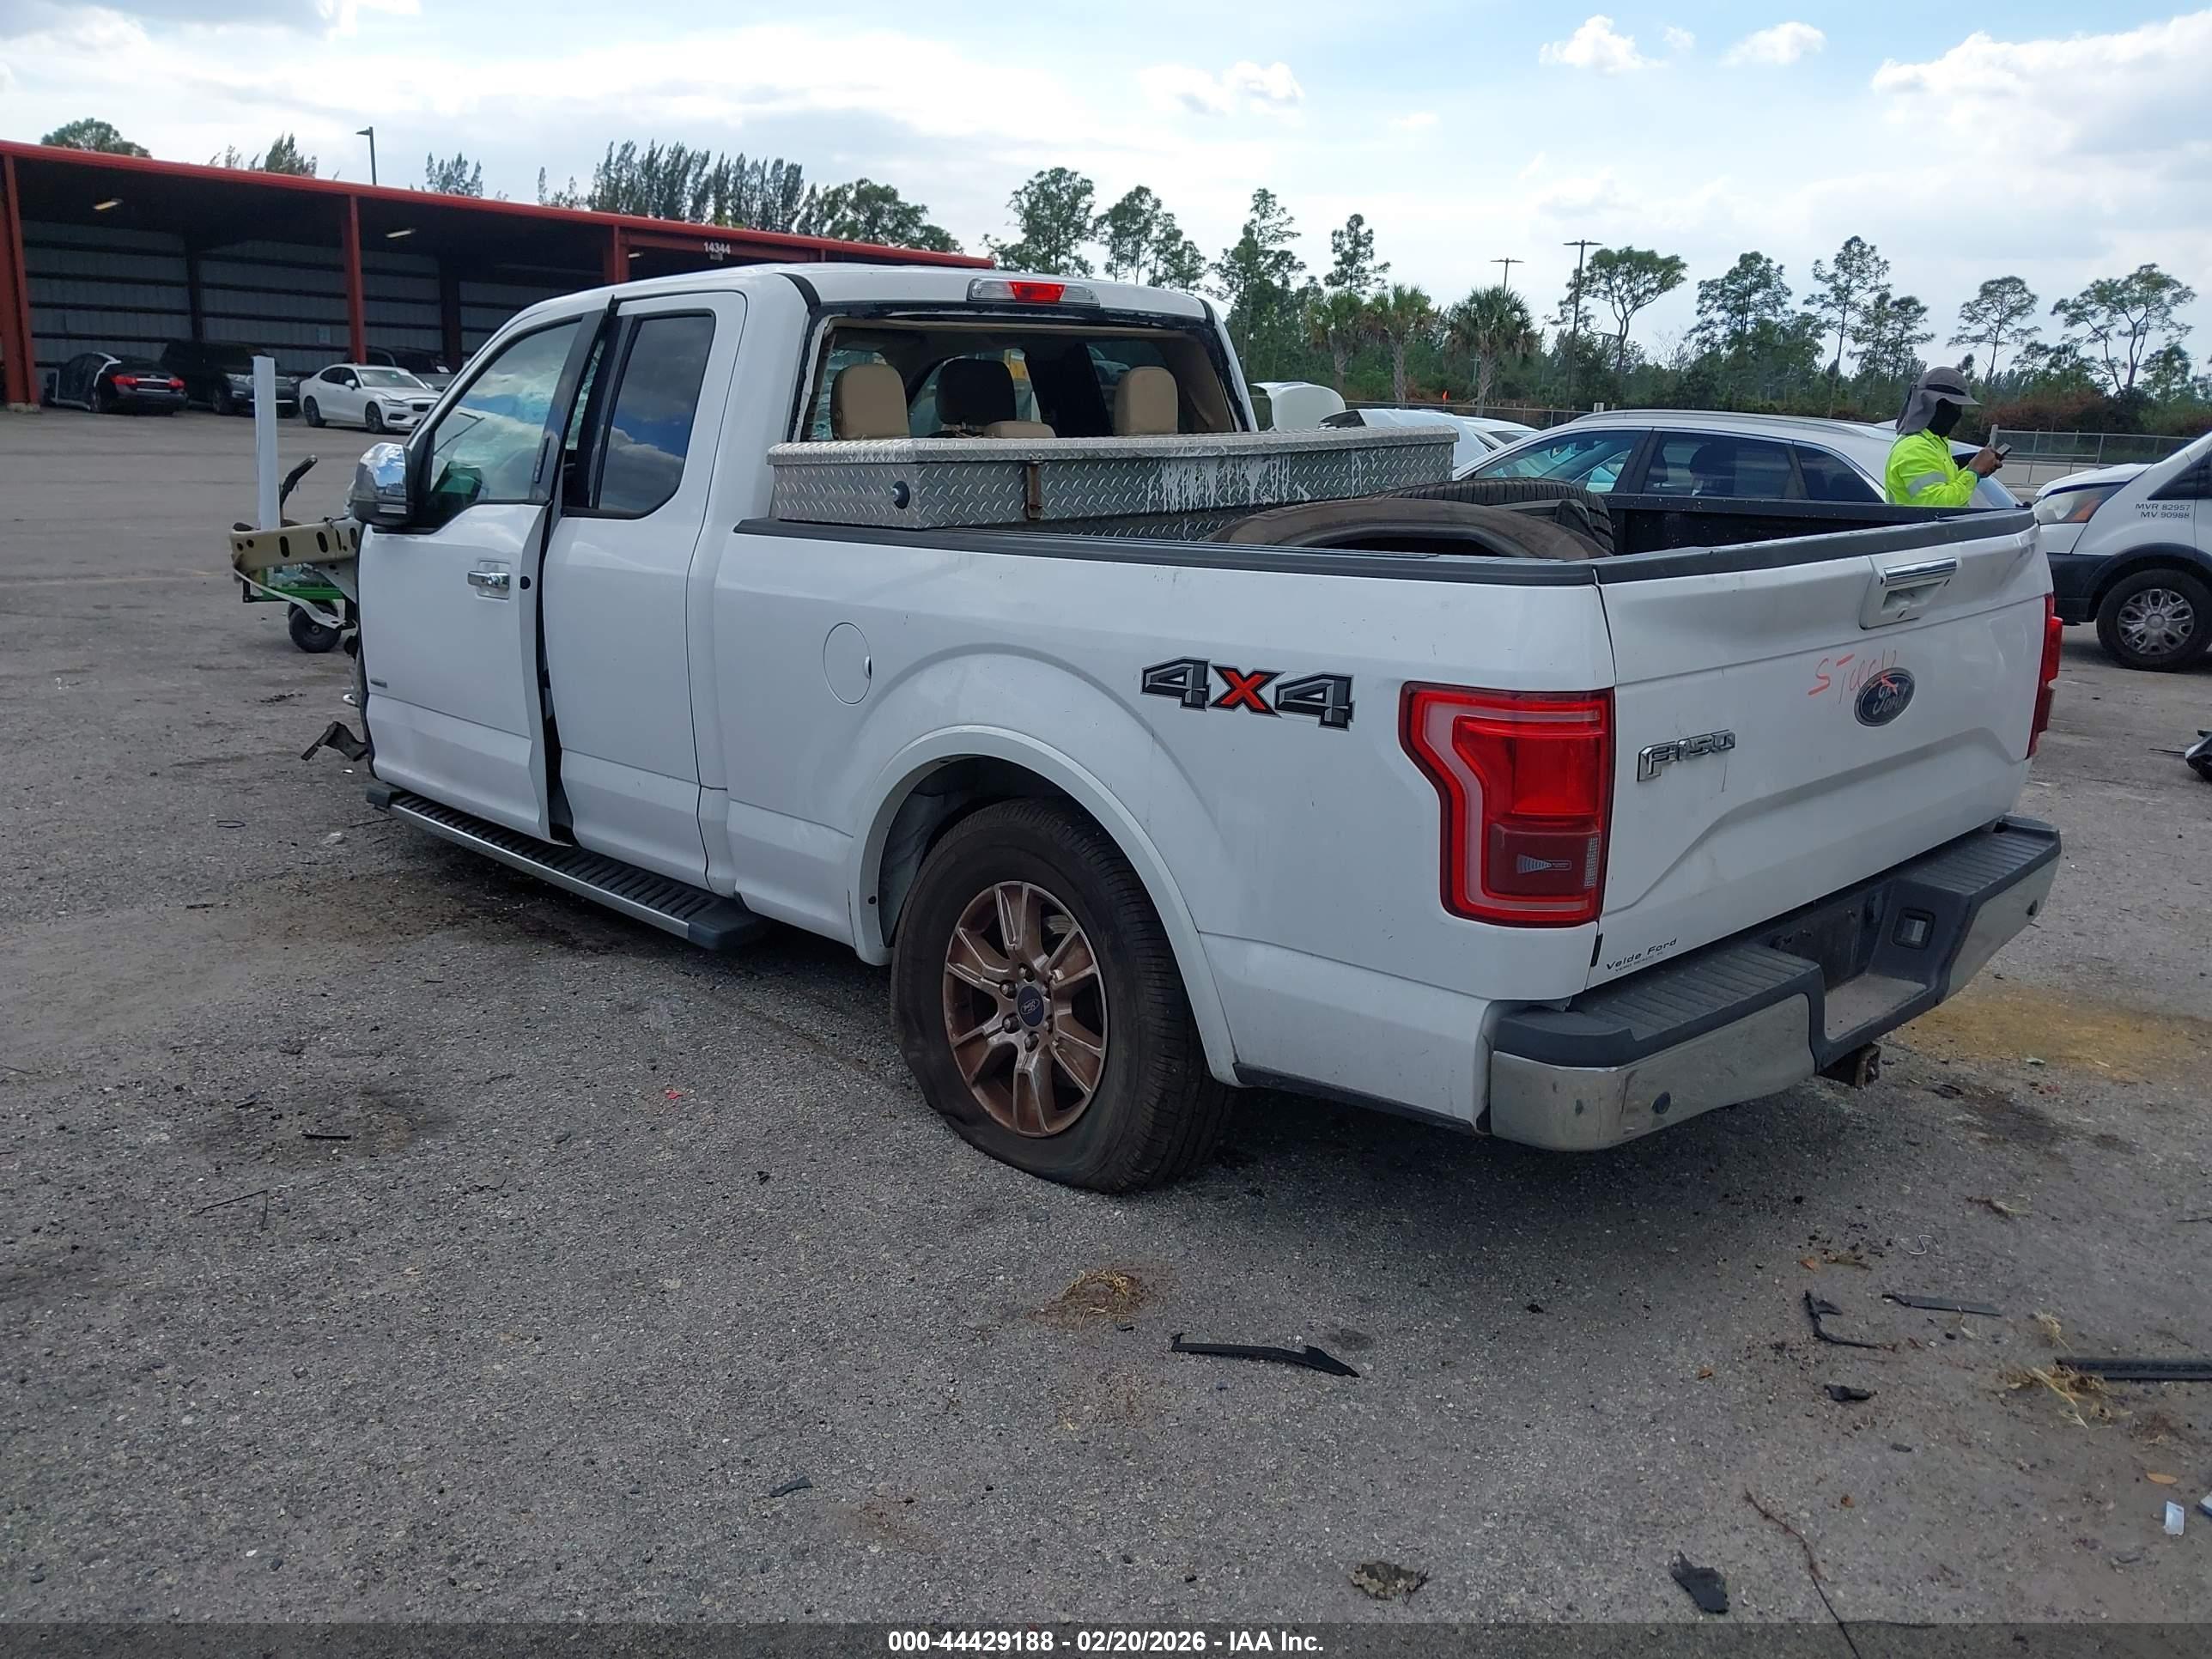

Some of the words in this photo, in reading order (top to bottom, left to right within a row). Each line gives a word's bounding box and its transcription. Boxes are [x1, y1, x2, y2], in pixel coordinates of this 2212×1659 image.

[703, 241, 731, 254] 14344
[1607, 952, 1642, 970] Velde
[1647, 938, 1678, 956] Ford
